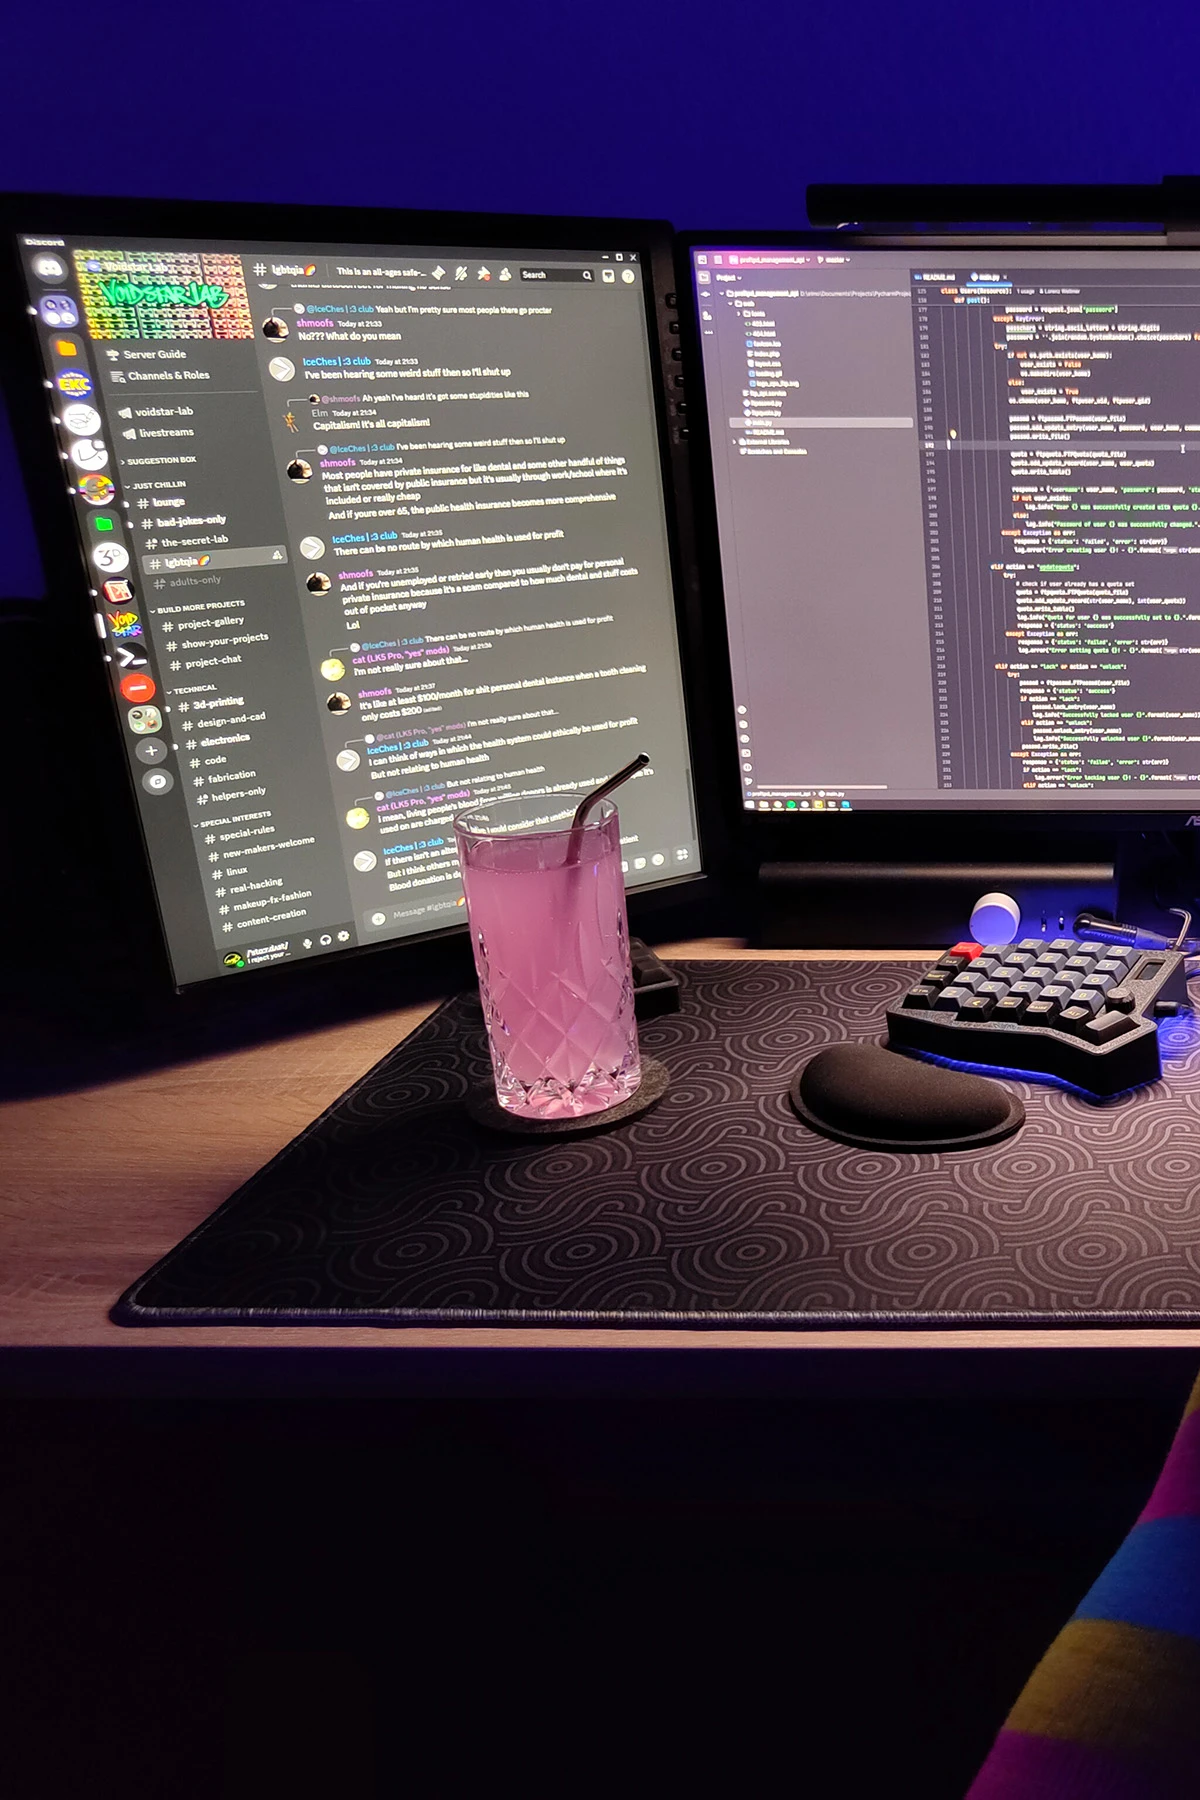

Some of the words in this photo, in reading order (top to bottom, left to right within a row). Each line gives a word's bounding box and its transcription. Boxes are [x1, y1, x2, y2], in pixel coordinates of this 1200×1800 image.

[24, 238, 65, 247] Discord
[272, 264, 304, 276] lgbtqia
[522, 270, 546, 281] Search
[297, 318, 334, 327] shmoofs
[298, 332, 324, 340] No???
[326, 332, 348, 340] What
[350, 332, 360, 340] do
[362, 334, 377, 342] you
[124, 349, 157, 360] Server
[160, 349, 186, 359] Guide
[303, 357, 337, 366] IceChes
[353, 357, 371, 365] club
[128, 370, 174, 381] Channels
[177, 370, 182, 379] &
[183, 369, 210, 380] Roles
[305, 370, 320, 379] I've
[320, 370, 342, 378] been
[344, 370, 376, 380] hearing
[398, 368, 421, 378] weird
[422, 368, 441, 377] stuff
[442, 368, 460, 376] then
[472, 368, 482, 376] I'll
[482, 367, 500, 376] shut
[501, 368, 512, 377] up
[59, 377, 91, 391] EKC
[135, 406, 194, 417] voidstar-lab
[313, 418, 360, 431] Capitalism!
[362, 419, 375, 429] It's
[377, 419, 386, 428] all
[387, 417, 430, 431] capitalism!
[140, 427, 194, 438] livestreams
[127, 456, 180, 466] SUGGESTION
[180, 455, 197, 464] BOX
[133, 481, 153, 489] JUST
[156, 480, 186, 488] CHILLIN
[153, 496, 186, 508] lounge
[157, 514, 226, 528] bad-jokes-only
[162, 534, 229, 546] the-secret-lab
[165, 556, 198, 568] lgbtqia
[170, 574, 221, 588] adults-only
[157, 606, 181, 614] BUILD
[183, 604, 205, 612] MORE
[207, 600, 246, 610] PROJECTS
[178, 616, 245, 630] project-gallery
[346, 620, 360, 630] Lol
[182, 632, 269, 650] show-your-projects
[388, 652, 404, 660] Pro,
[405, 649, 424, 658] "yes"
[426, 646, 450, 655] mods)
[185, 654, 242, 669] project-chat
[174, 684, 217, 695] TECHNICAL
[193, 696, 245, 710] 3d-printing
[197, 711, 267, 728] design-and-cad
[362, 712, 378, 722] only
[380, 710, 400, 719] costs
[401, 706, 422, 716] $200
[201, 734, 251, 748] electronics
[205, 755, 227, 766] code
[208, 769, 257, 785] fabrication
[212, 786, 267, 802] helpers-only
[201, 816, 231, 828] SPECIAL
[233, 811, 272, 823] INTERESTS
[220, 825, 276, 842] special-rules
[223, 835, 315, 859] new-makers-welcome
[226, 865, 248, 876] linux
[230, 877, 283, 894] real-hacking
[234, 889, 312, 912] makeup-fx-fashion
[237, 908, 307, 928] content-creation
